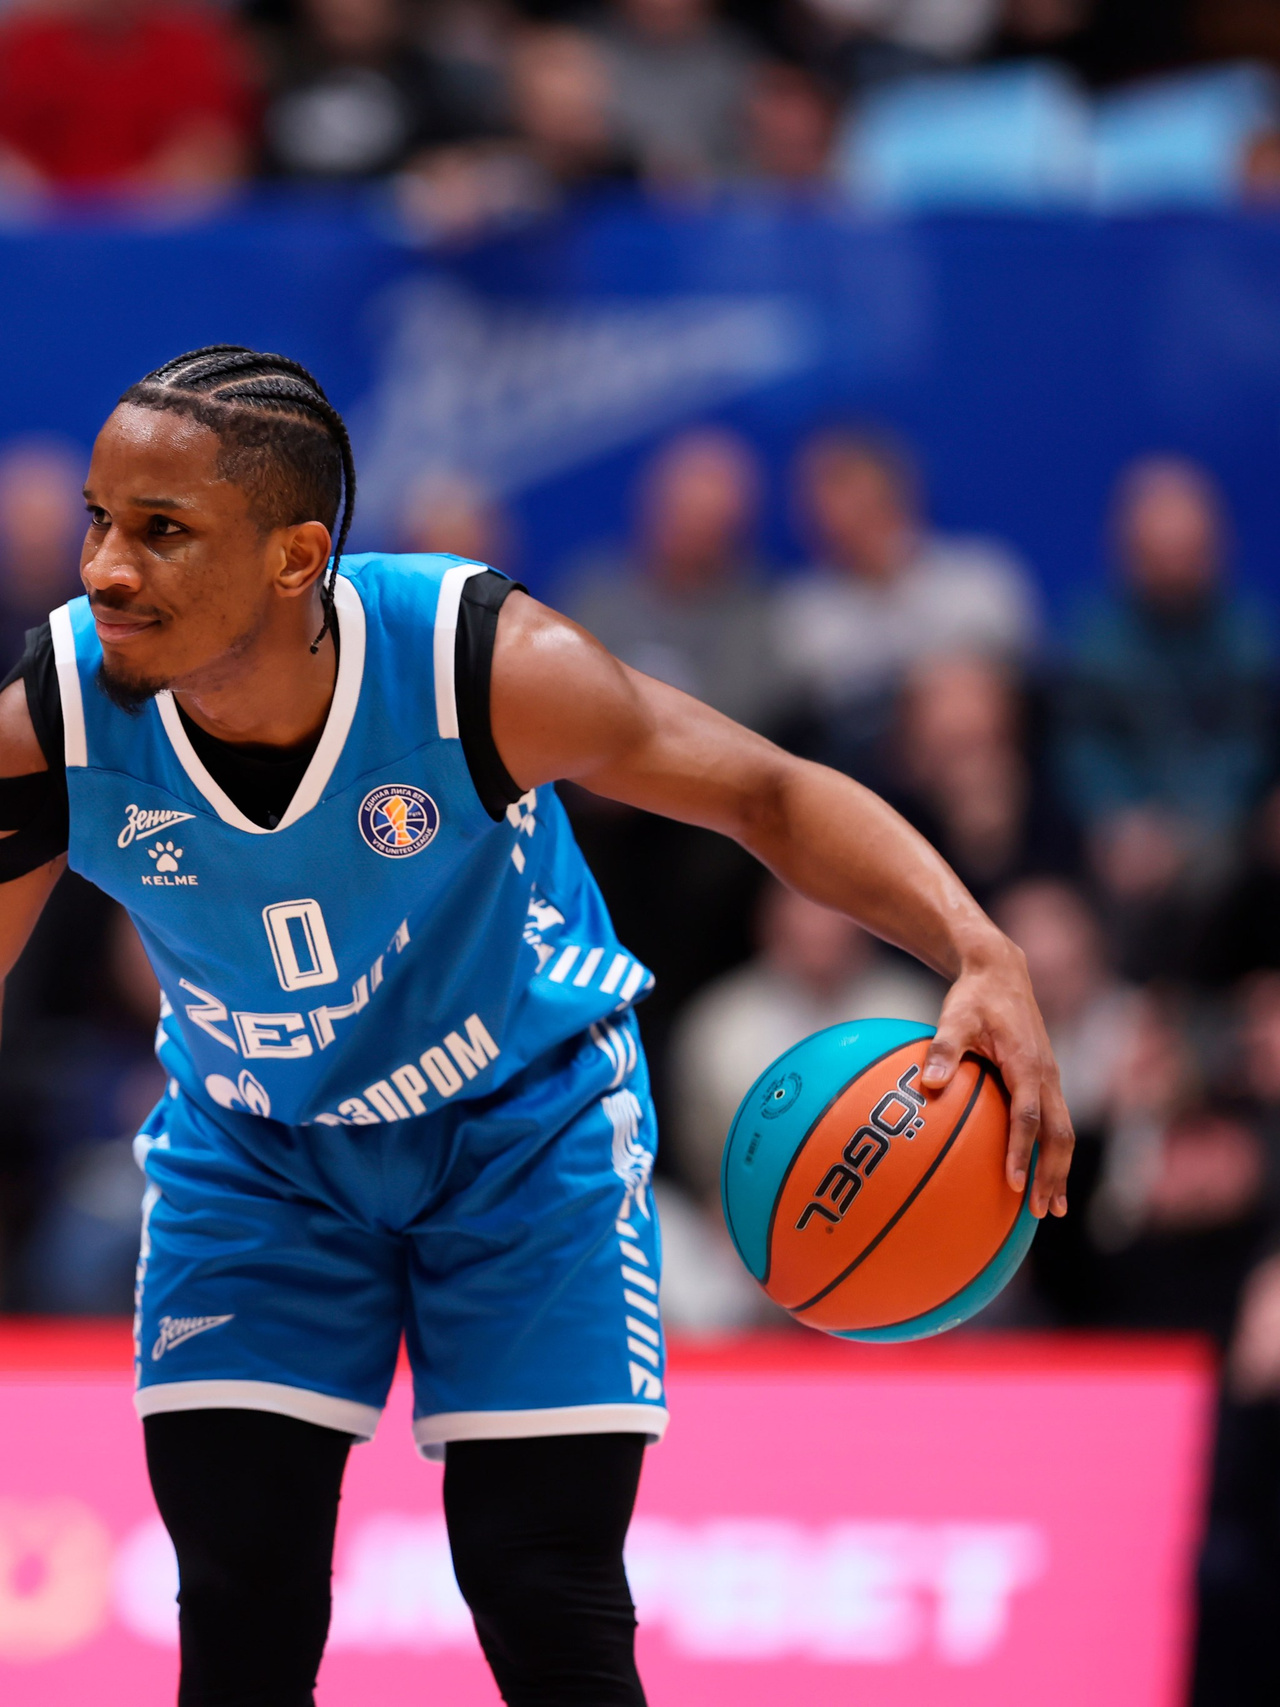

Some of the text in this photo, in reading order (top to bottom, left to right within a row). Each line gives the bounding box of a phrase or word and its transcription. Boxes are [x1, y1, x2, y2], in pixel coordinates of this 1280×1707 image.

[364, 790, 389, 812] ЕДИНАЯ
[372, 839, 384, 850] VTB
[414, 827, 433, 848] LEAGUE
[141, 875, 199, 886] KELME
[262, 898, 339, 992] 0
[303, 1013, 500, 1126] ЗПРОМ
[794, 1063, 927, 1231] JÖGEL
